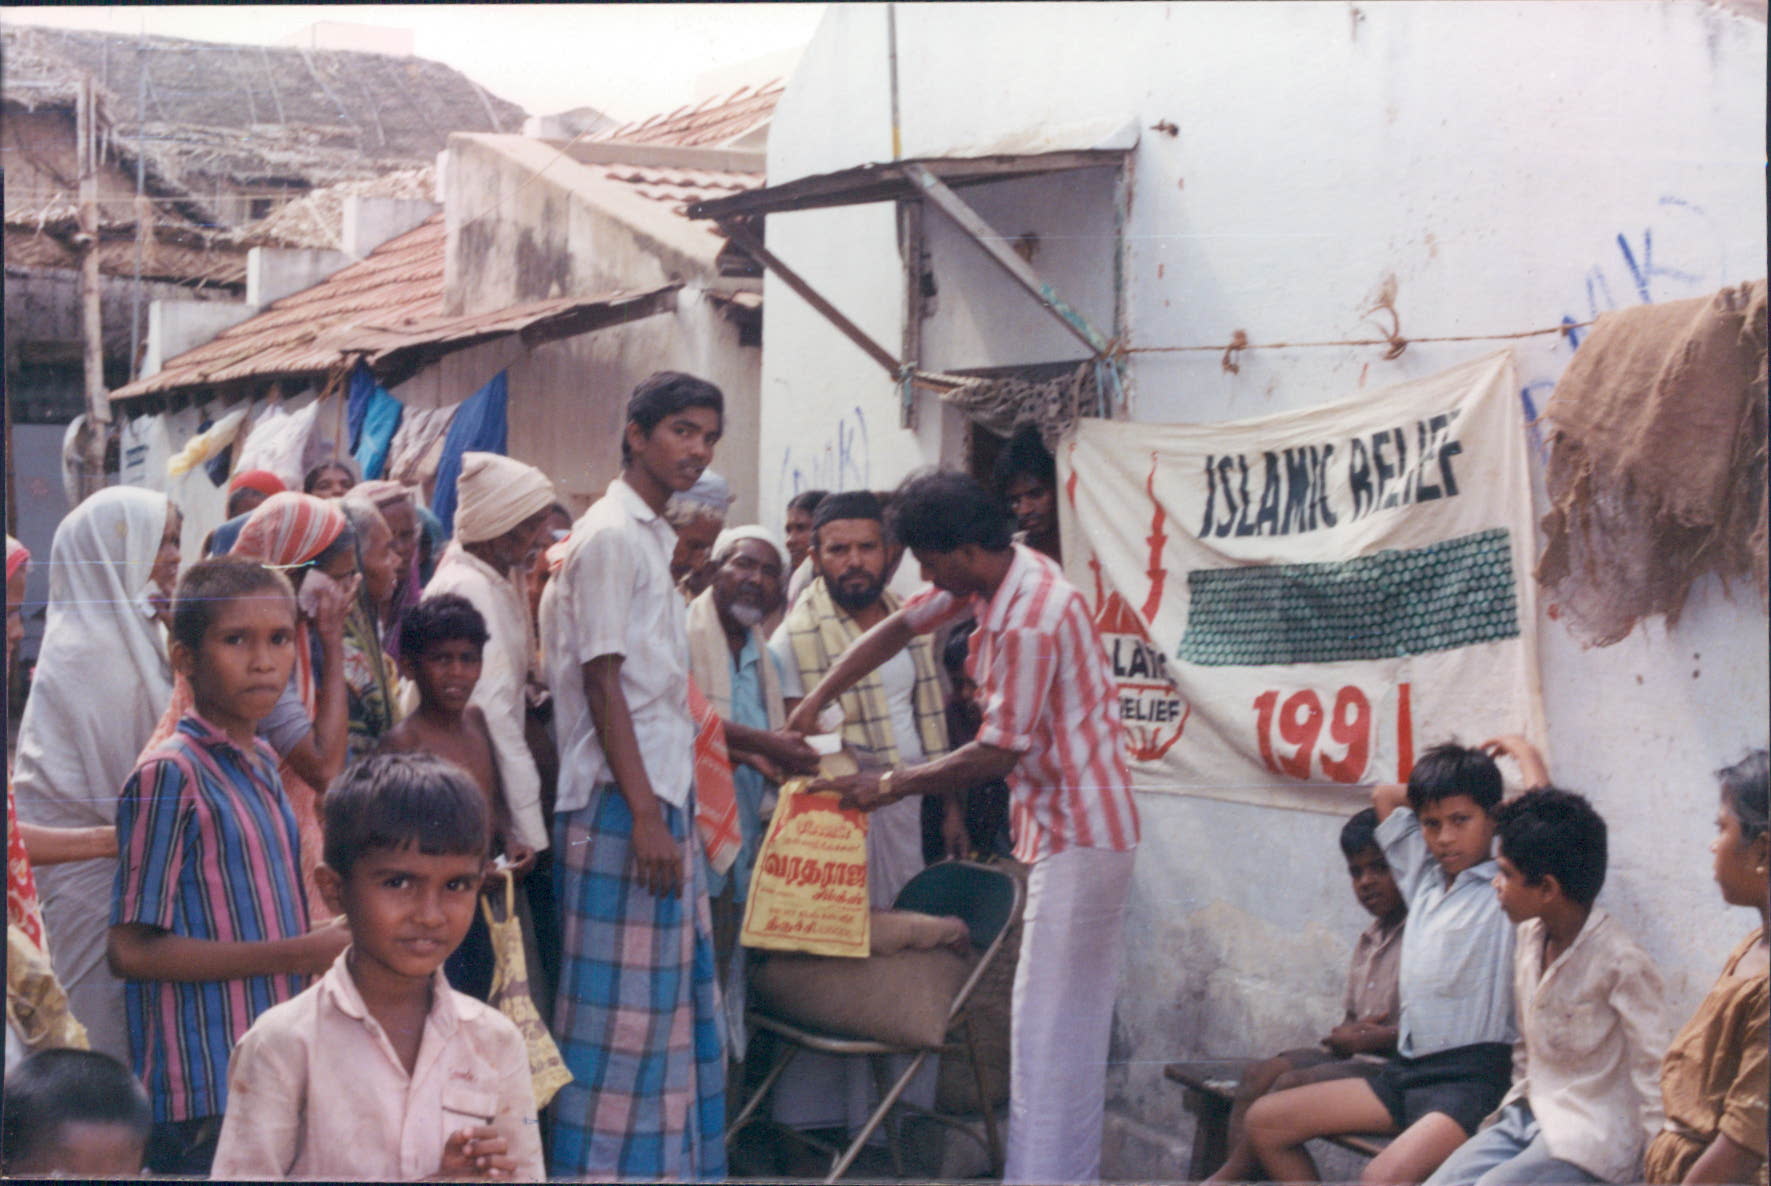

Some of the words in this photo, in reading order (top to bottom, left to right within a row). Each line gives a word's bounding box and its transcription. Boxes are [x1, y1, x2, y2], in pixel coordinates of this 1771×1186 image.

[1198, 443, 1338, 538] ISLAMIC
[1350, 408, 1464, 521] RELIEF
[1252, 682, 1414, 784] 1991
